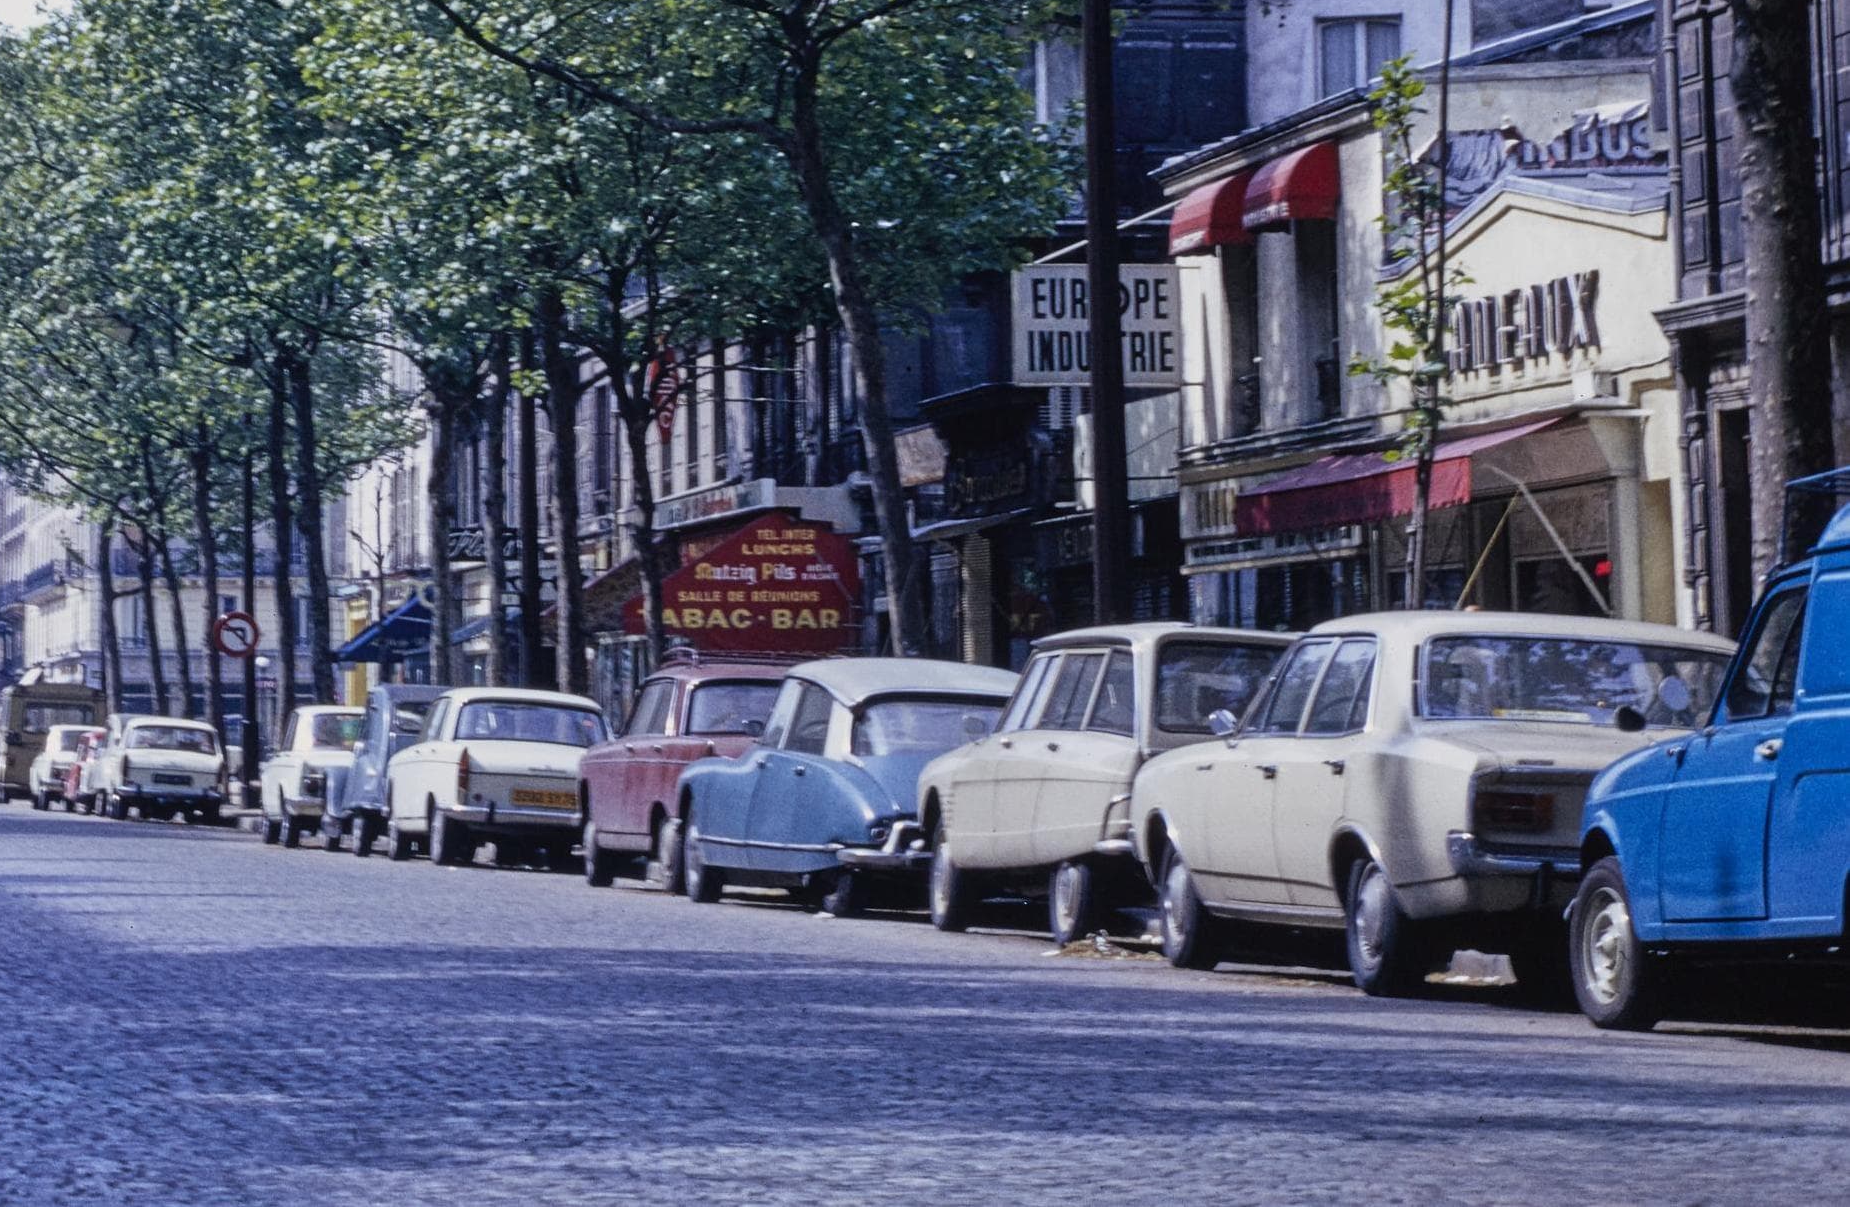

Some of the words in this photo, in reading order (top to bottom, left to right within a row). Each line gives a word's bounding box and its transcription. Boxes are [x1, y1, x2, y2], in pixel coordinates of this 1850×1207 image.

[1448, 270, 1601, 373] ADEAUX
[1027, 330, 1174, 372] INDURIE
[741, 543, 816, 555] LUNCHS
[761, 562, 797, 580] Pils
[678, 590, 723, 602] SALLE
[727, 590, 745, 602] DE
[771, 609, 840, 629] BAR
